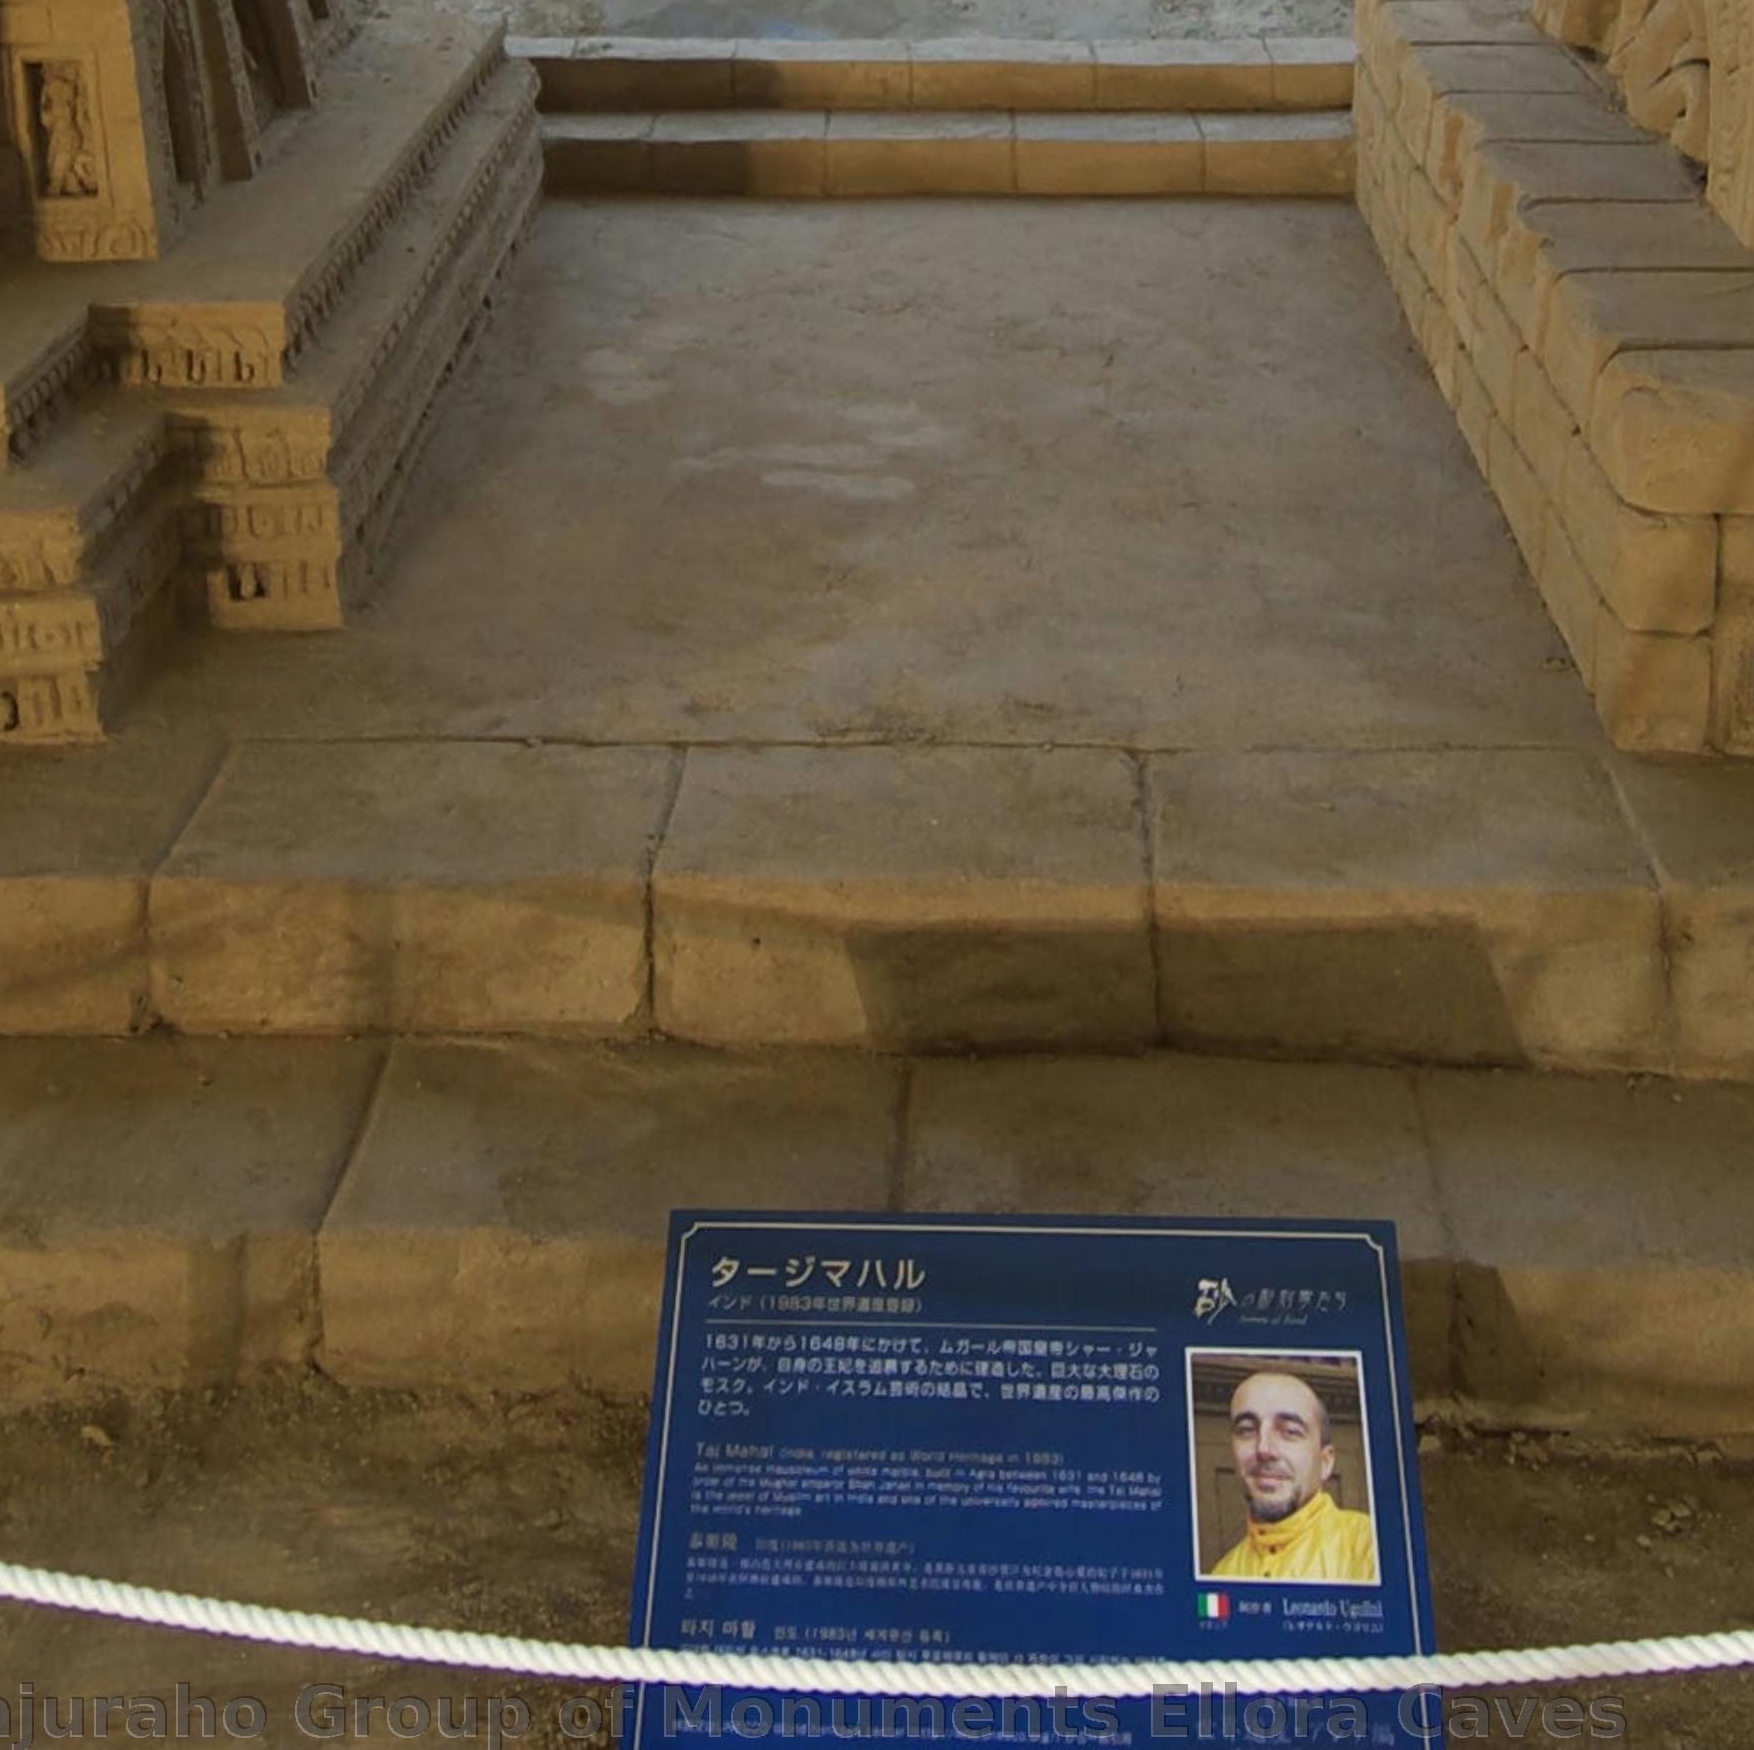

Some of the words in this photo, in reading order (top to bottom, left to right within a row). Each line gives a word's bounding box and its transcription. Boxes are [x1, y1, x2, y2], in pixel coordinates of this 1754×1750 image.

[711, 1256, 926, 1291] タージマハル
[697, 1400, 750, 1416] ひとつ。
